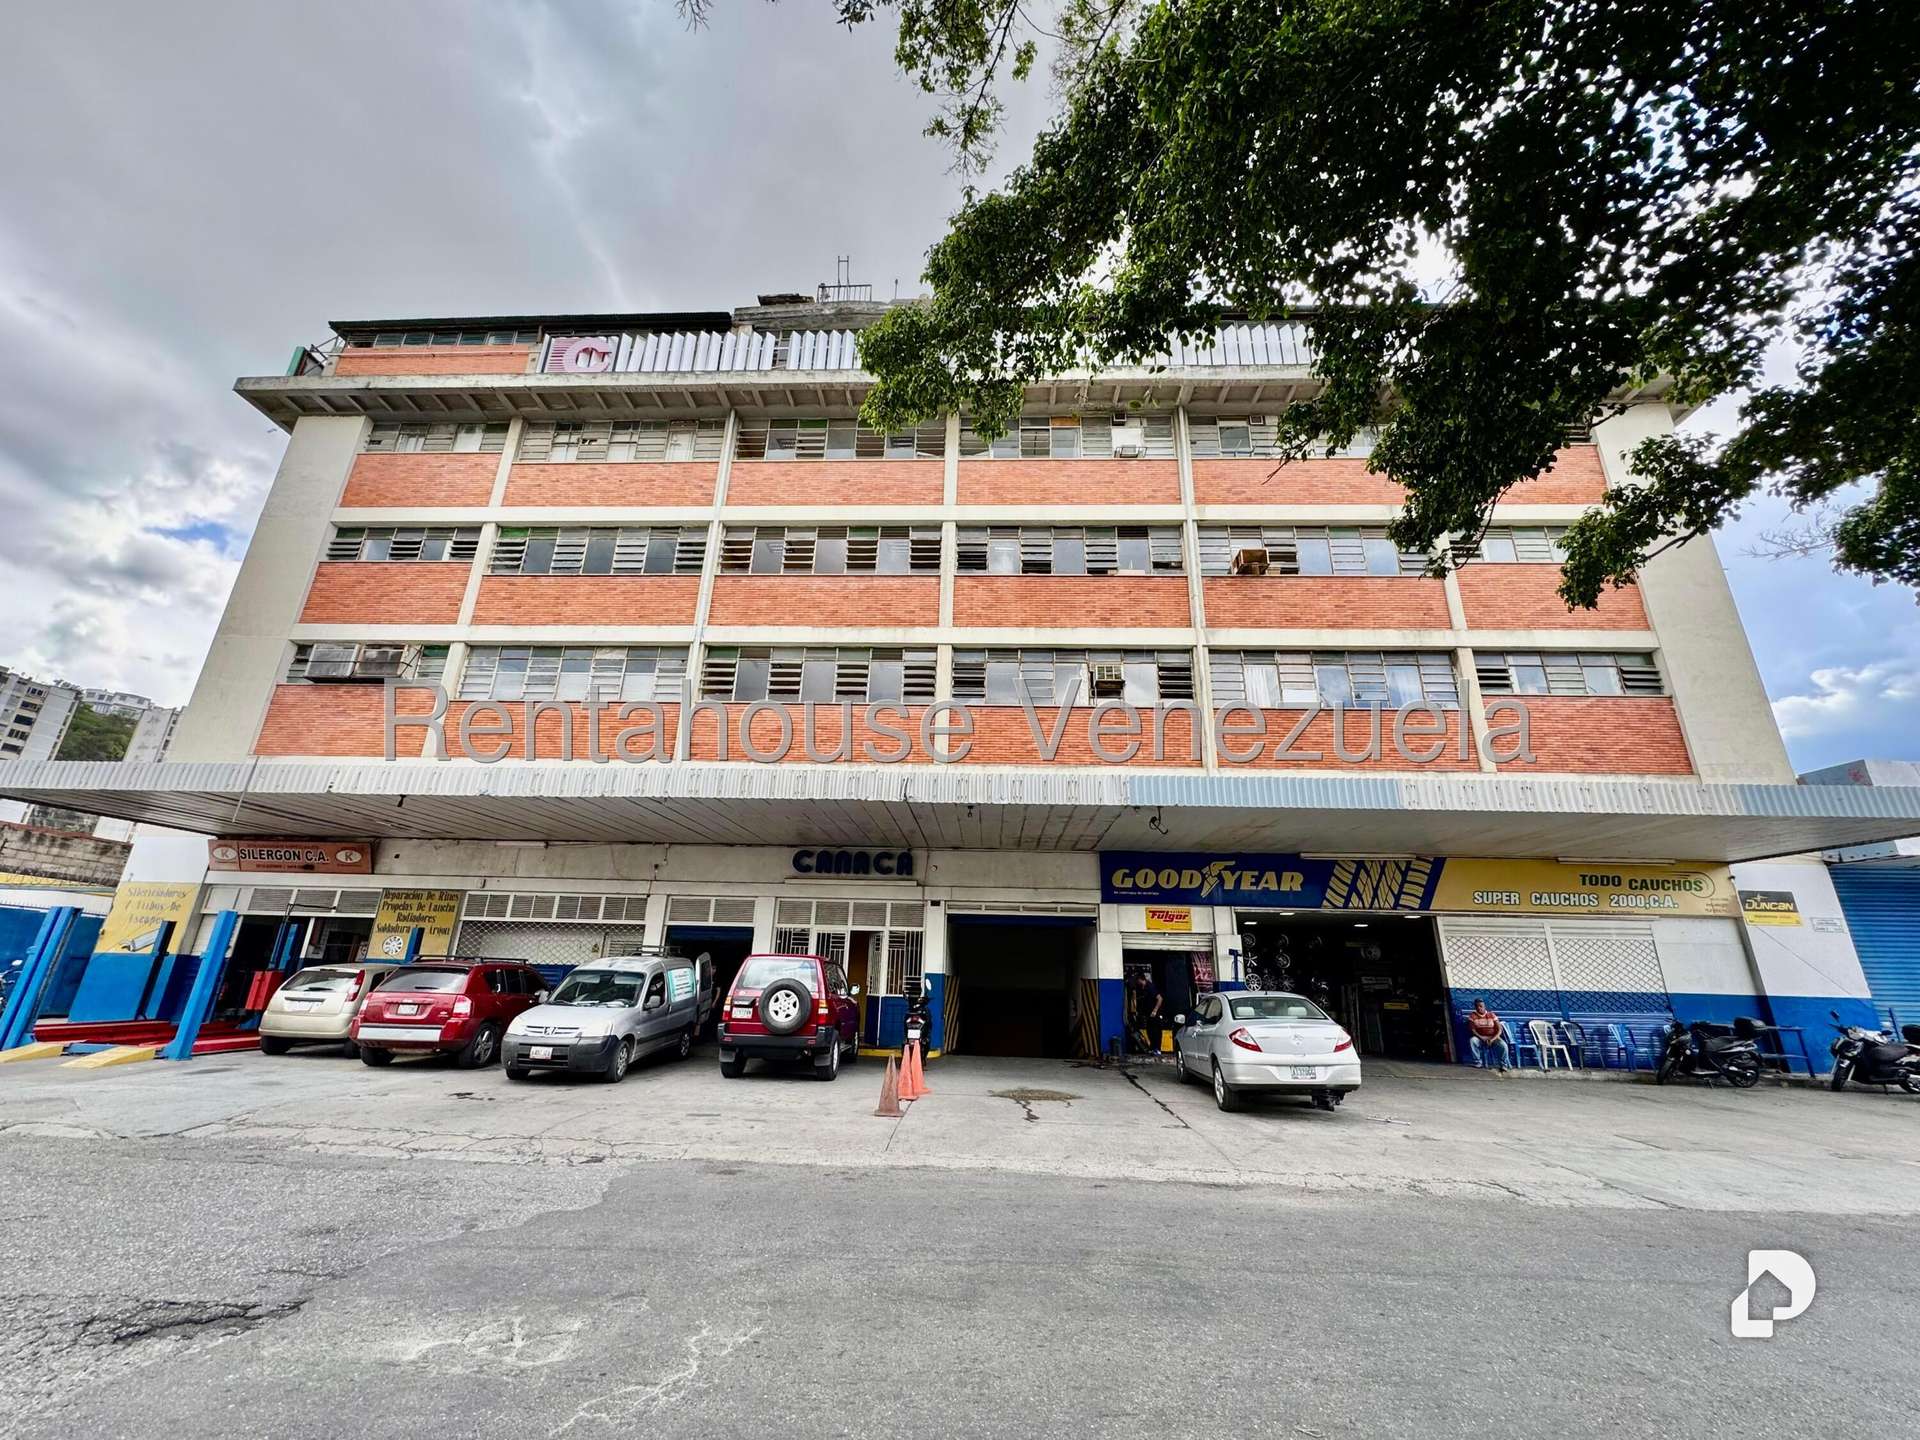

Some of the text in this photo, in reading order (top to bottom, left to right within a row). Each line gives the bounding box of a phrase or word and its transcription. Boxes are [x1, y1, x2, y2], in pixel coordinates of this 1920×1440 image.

[240, 848, 330, 862] SILERGON C.A.
[1579, 873, 1704, 892] TODO CAUCHOS
[1473, 891, 1520, 905] SUPER
[1531, 892, 1598, 906] CAUCHOS
